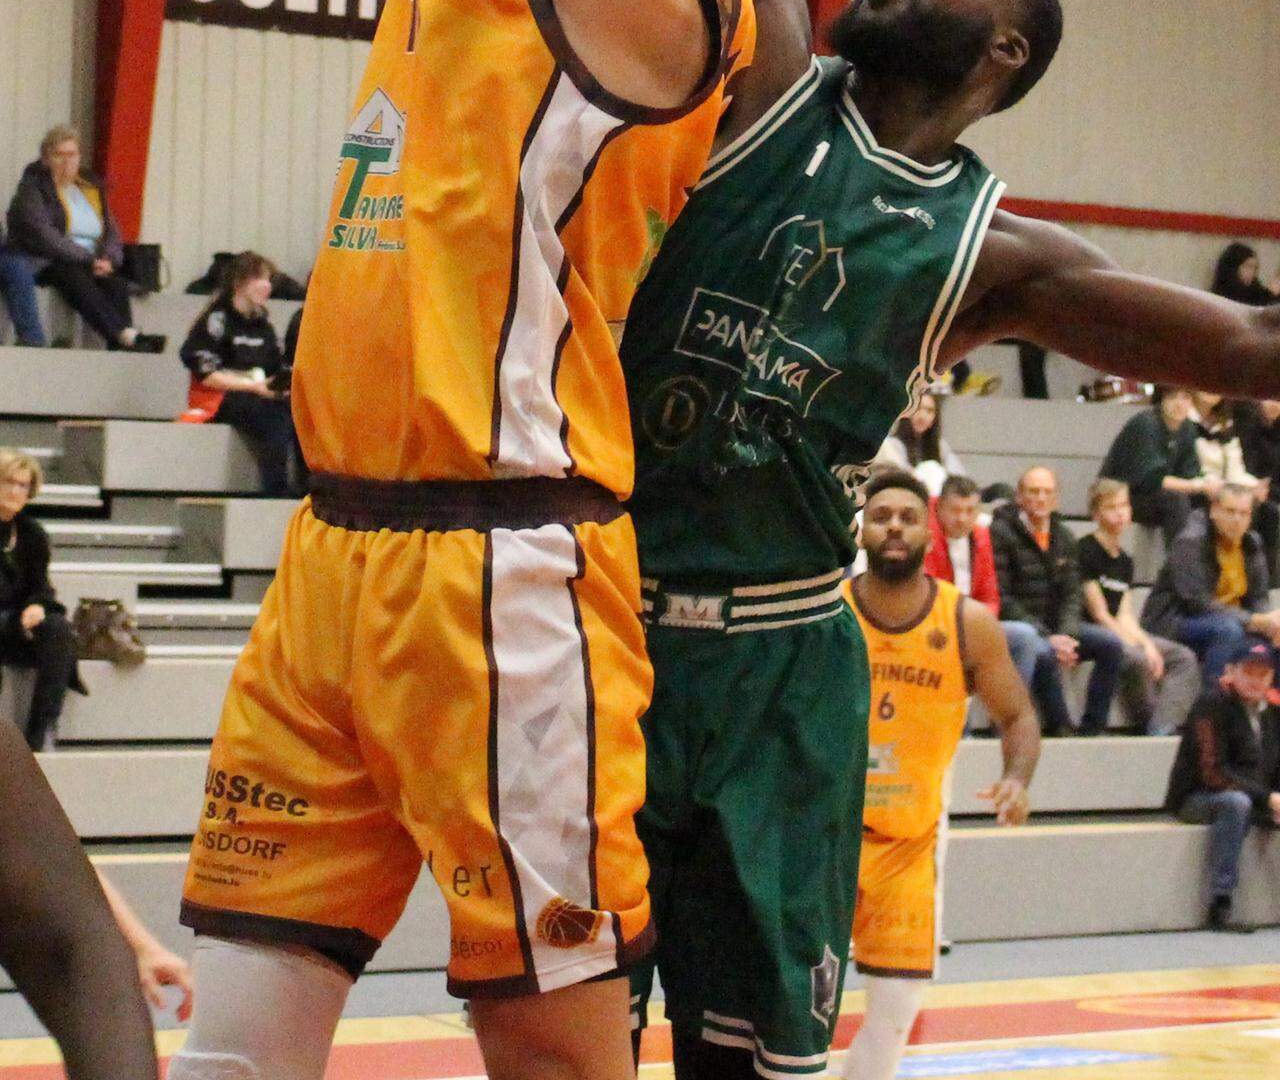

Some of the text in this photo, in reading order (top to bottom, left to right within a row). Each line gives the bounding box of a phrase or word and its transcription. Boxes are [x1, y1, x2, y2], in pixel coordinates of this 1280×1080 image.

[805, 141, 831, 177] 1
[870, 662, 943, 690] FINGEN
[878, 691, 895, 721] 6
